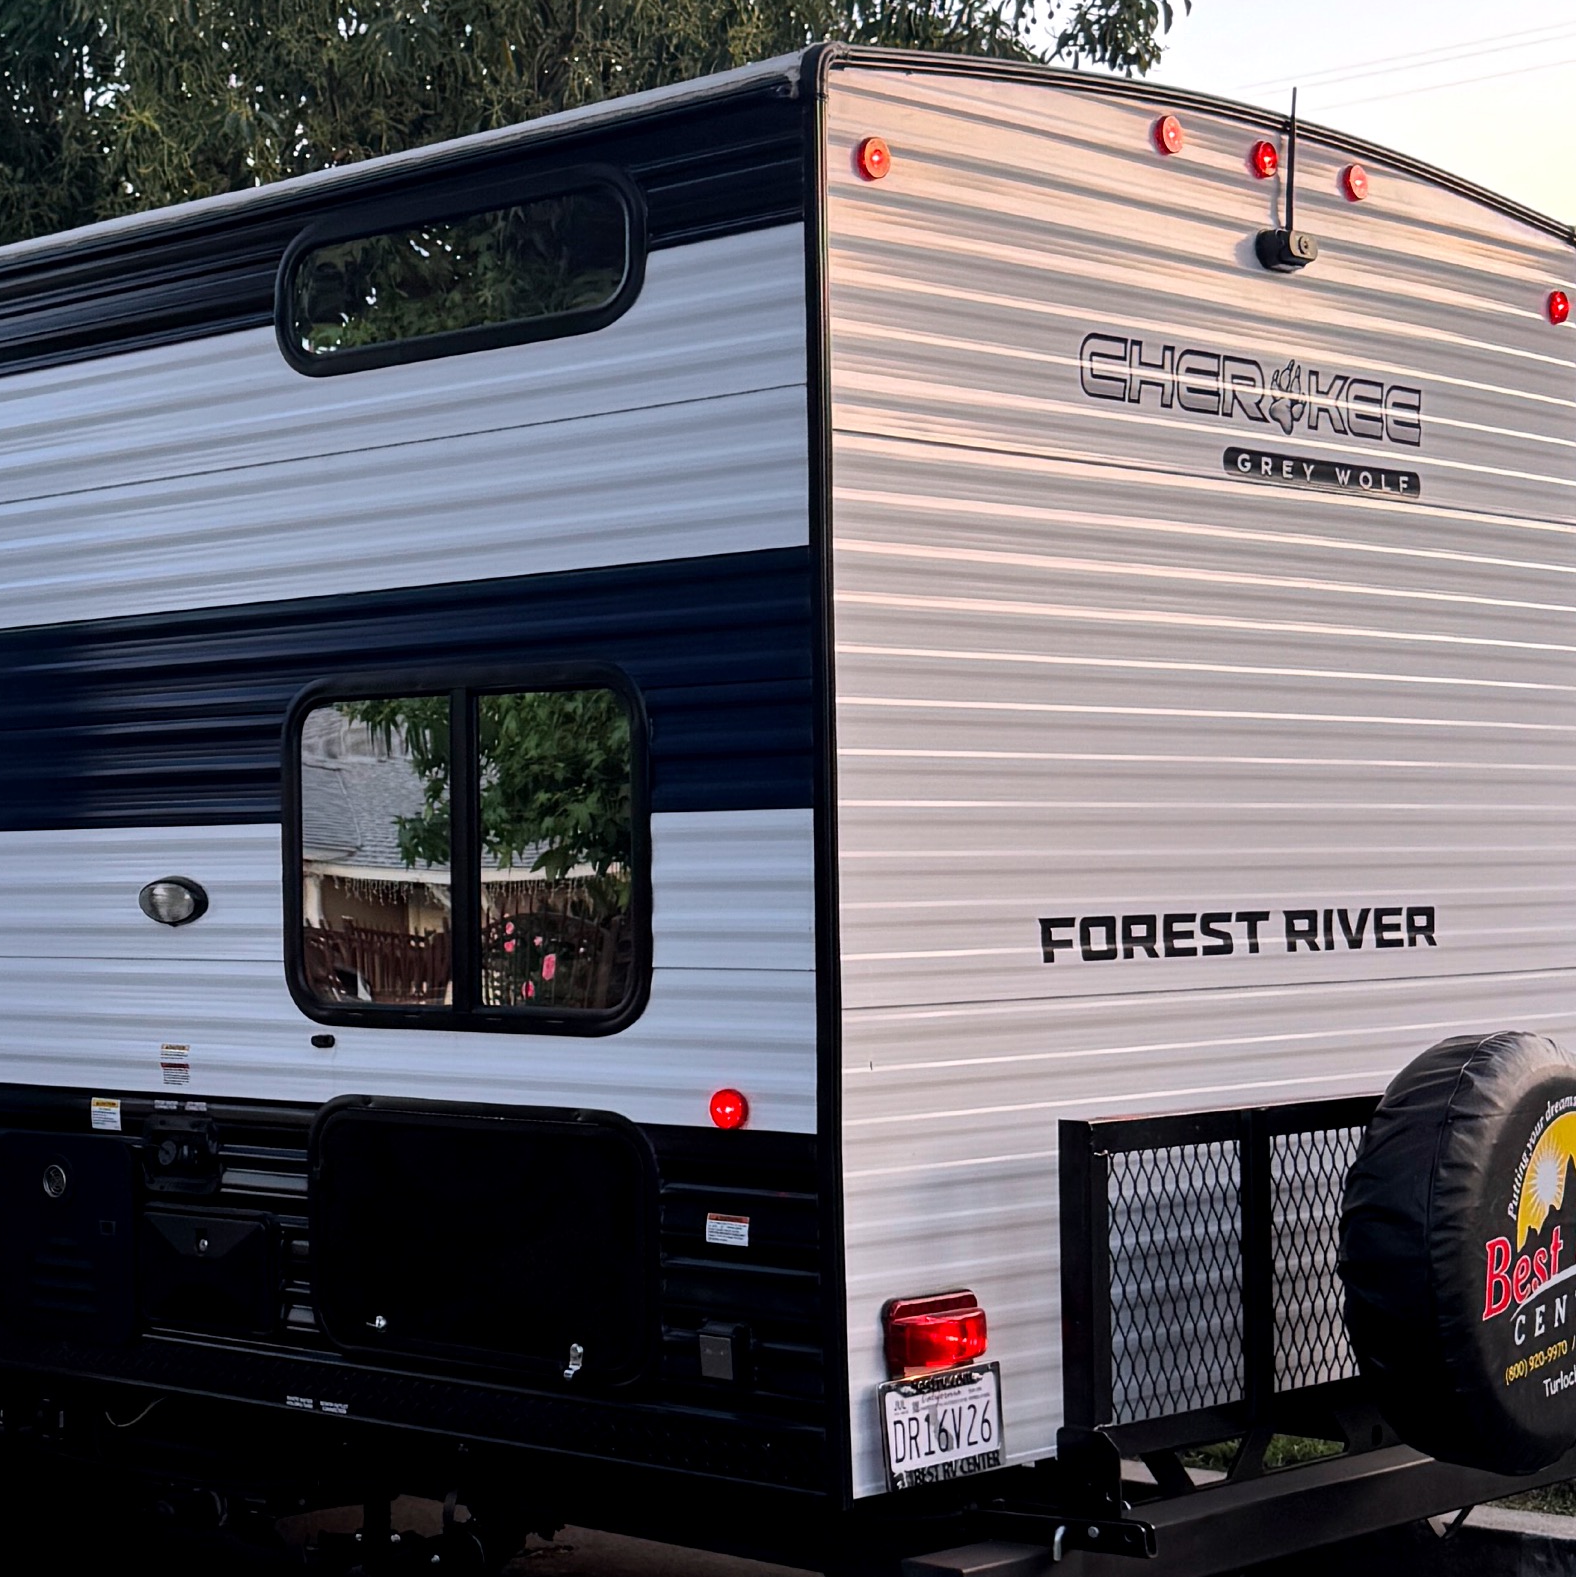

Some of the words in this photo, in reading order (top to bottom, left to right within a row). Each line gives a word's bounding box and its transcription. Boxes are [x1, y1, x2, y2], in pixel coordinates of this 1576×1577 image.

[1237, 453, 1315, 484] GREY
[1335, 467, 1409, 494] WOLF
[1038, 910, 1270, 963] FOREST
[1282, 906, 1437, 952] RIVER
[1507, 1149, 1529, 1221] Putting
[1526, 1115, 1545, 1157] your
[1482, 1225, 1564, 1322] Best
[1514, 1290, 1576, 1346] CEN
[1505, 1358, 1528, 1386] (800)
[1529, 1339, 1568, 1372] 920-9970
[893, 1400, 992, 1464] DR16V26
[913, 1461, 940, 1485] BEST
[944, 1459, 958, 1479] RV
[960, 1450, 1002, 1474] CENTER
